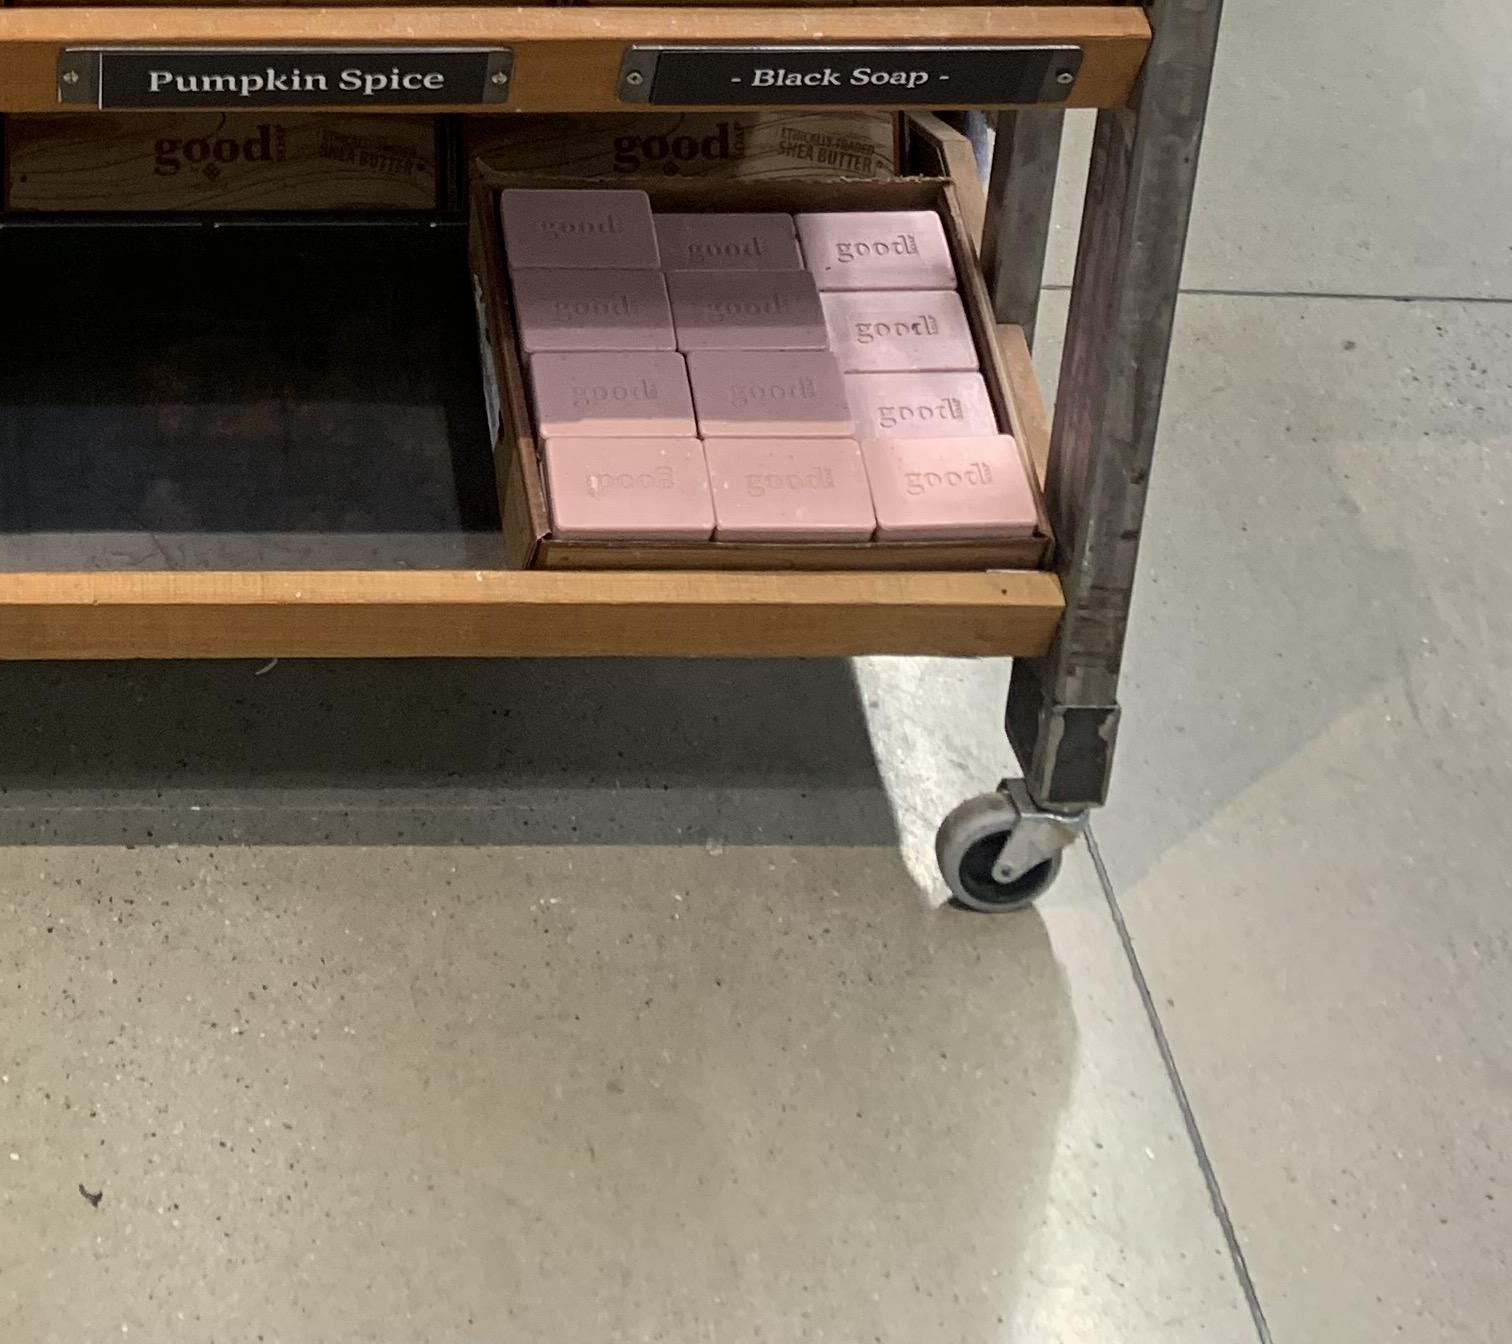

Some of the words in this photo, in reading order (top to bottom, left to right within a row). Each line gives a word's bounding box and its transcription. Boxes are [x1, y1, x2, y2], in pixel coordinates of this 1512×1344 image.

[149, 67, 328, 97] Pumpkin
[339, 67, 445, 95] Spice
[751, 67, 841, 87] Black
[850, 66, 928, 90] Soap
[153, 123, 273, 177] good
[612, 120, 730, 174] good
[776, 139, 816, 162] SHEA
[816, 146, 874, 174] BUTTER
[836, 234, 913, 263] good
[855, 315, 932, 344] good
[878, 398, 957, 429] good
[904, 462, 988, 496] good
